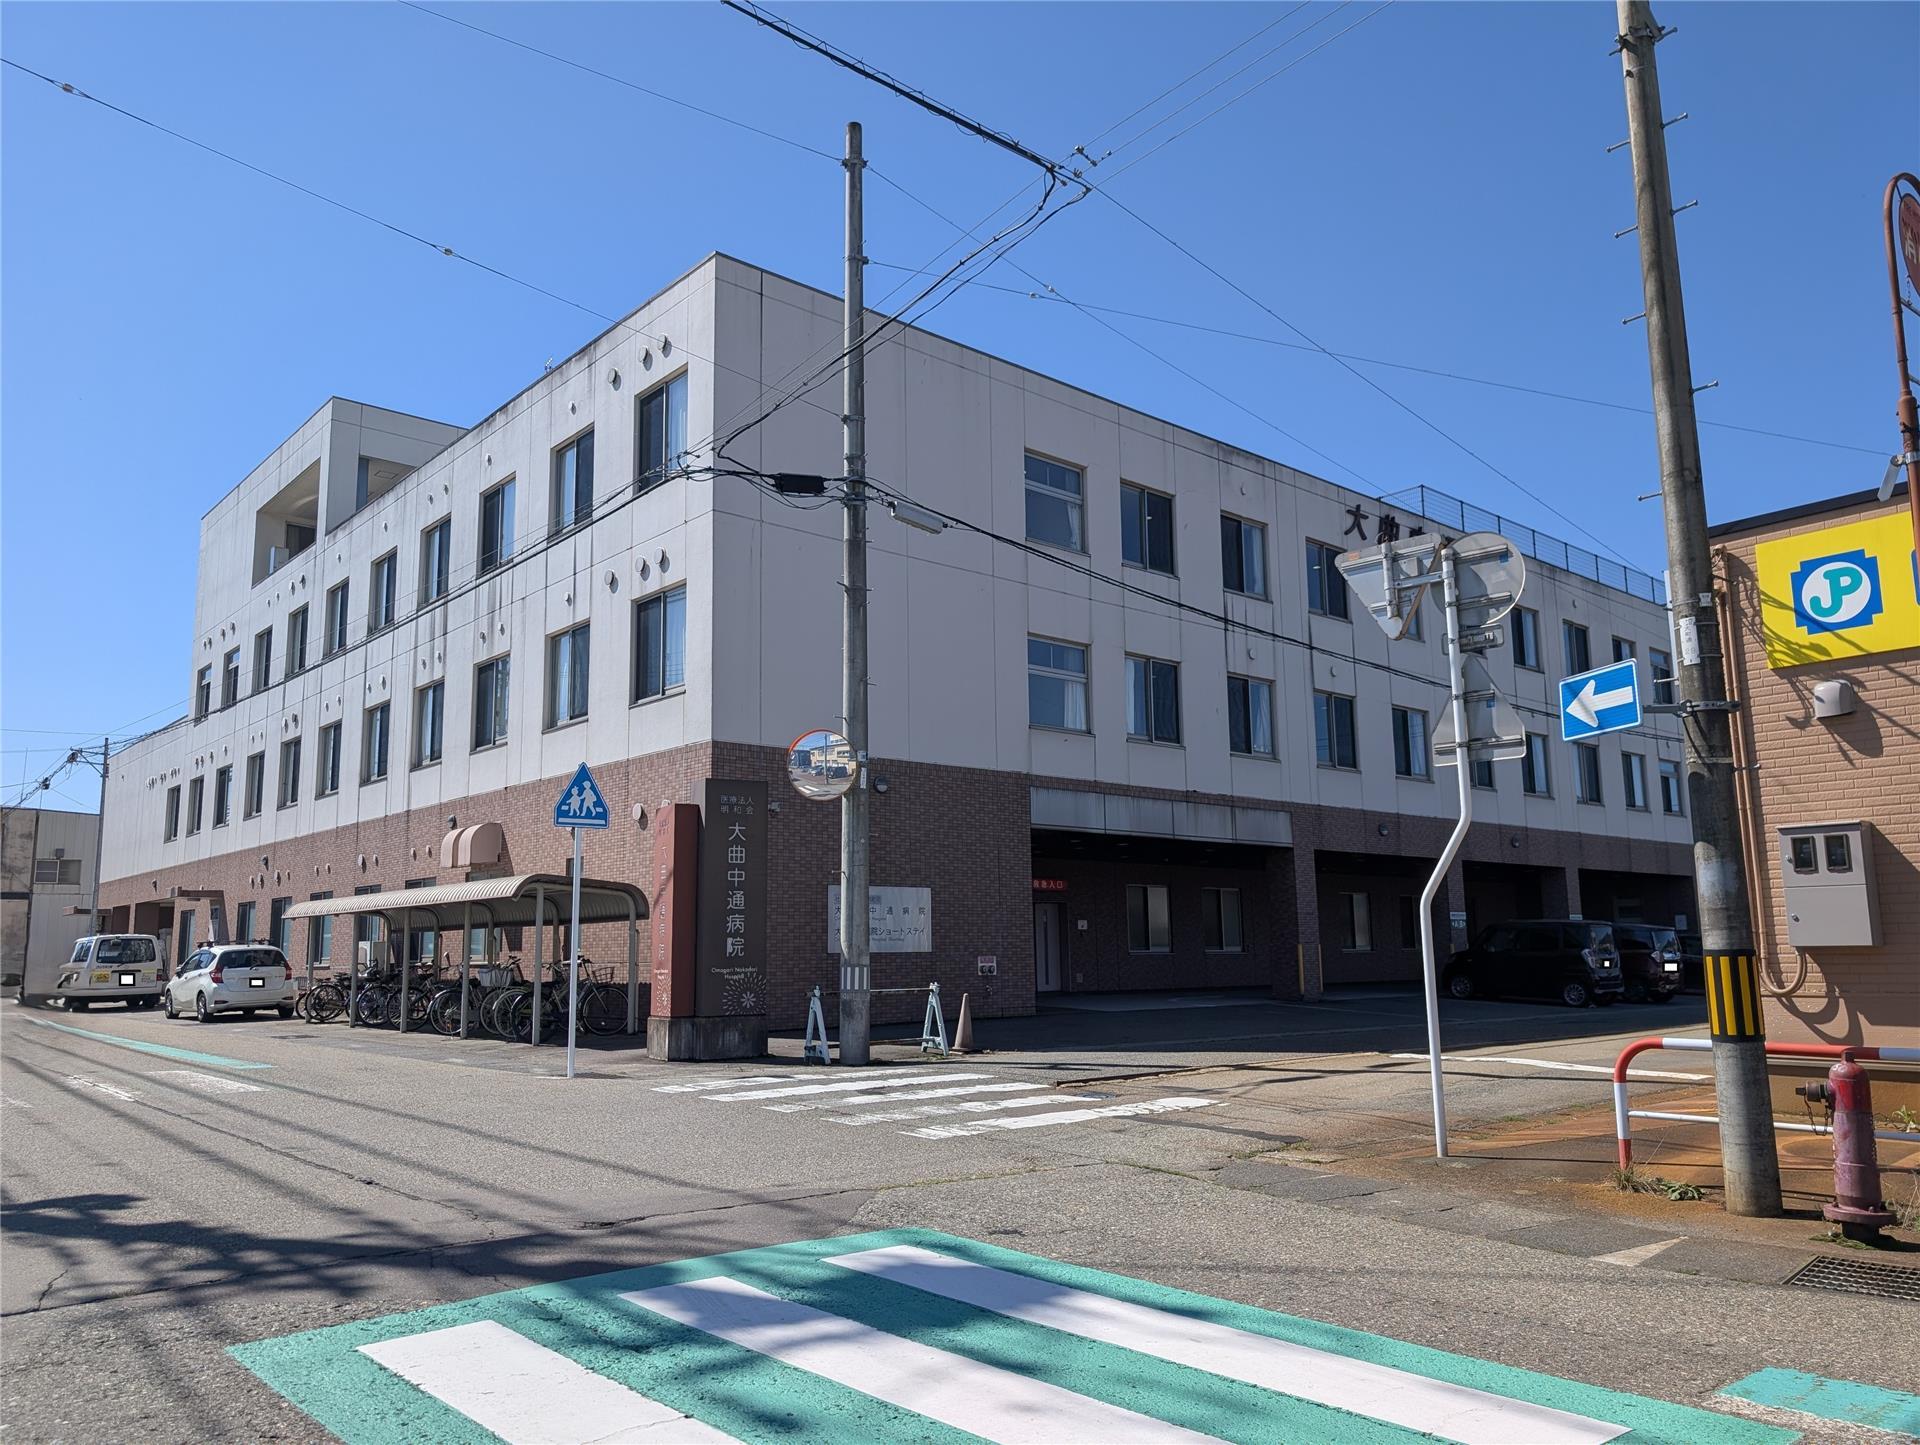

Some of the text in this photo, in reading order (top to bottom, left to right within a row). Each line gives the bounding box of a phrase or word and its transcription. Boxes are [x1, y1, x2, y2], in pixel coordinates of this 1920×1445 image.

[1809, 566, 1863, 618] JP
[726, 822, 746, 957] 大曲中通病院
[834, 905, 926, 916] 大中通病院
